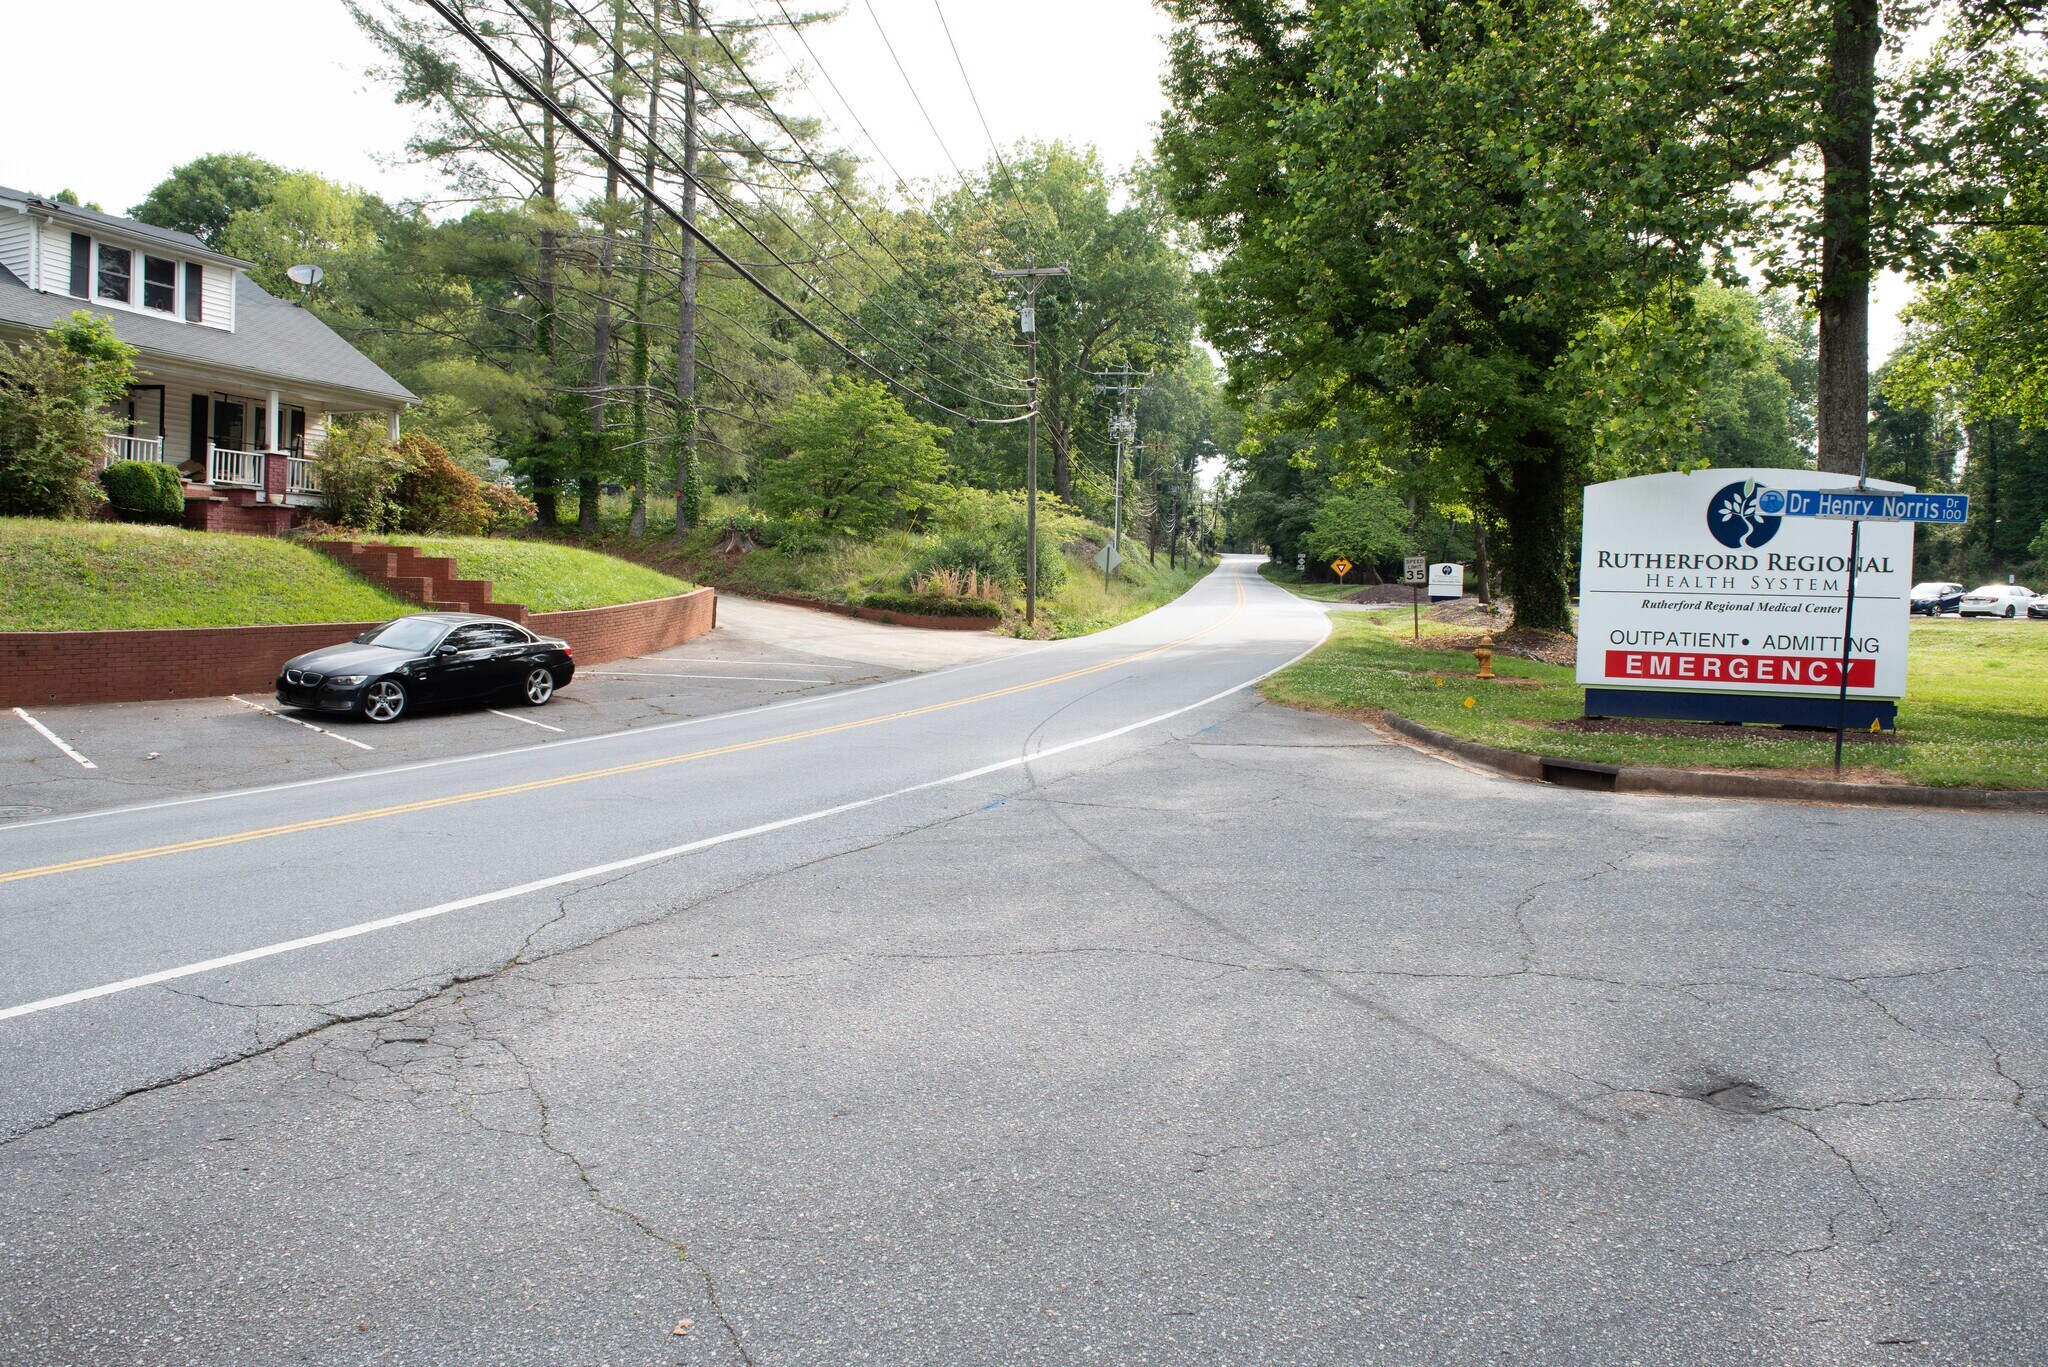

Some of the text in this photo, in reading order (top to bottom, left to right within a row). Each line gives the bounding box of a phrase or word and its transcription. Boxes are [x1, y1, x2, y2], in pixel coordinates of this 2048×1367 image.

[1790, 493, 1959, 519] Dr Henry Norris Dr
[1942, 509, 1962, 520] 100
[1597, 550, 1893, 573] RUTHERFORD REGIONAL
[1406, 570, 1424, 580] 35
[1646, 574, 1839, 591] HEALTH SYSTEM
[1641, 599, 1843, 614] Rutherford Regional Medical Center
[1762, 635, 1879, 654] ADMITTNG
